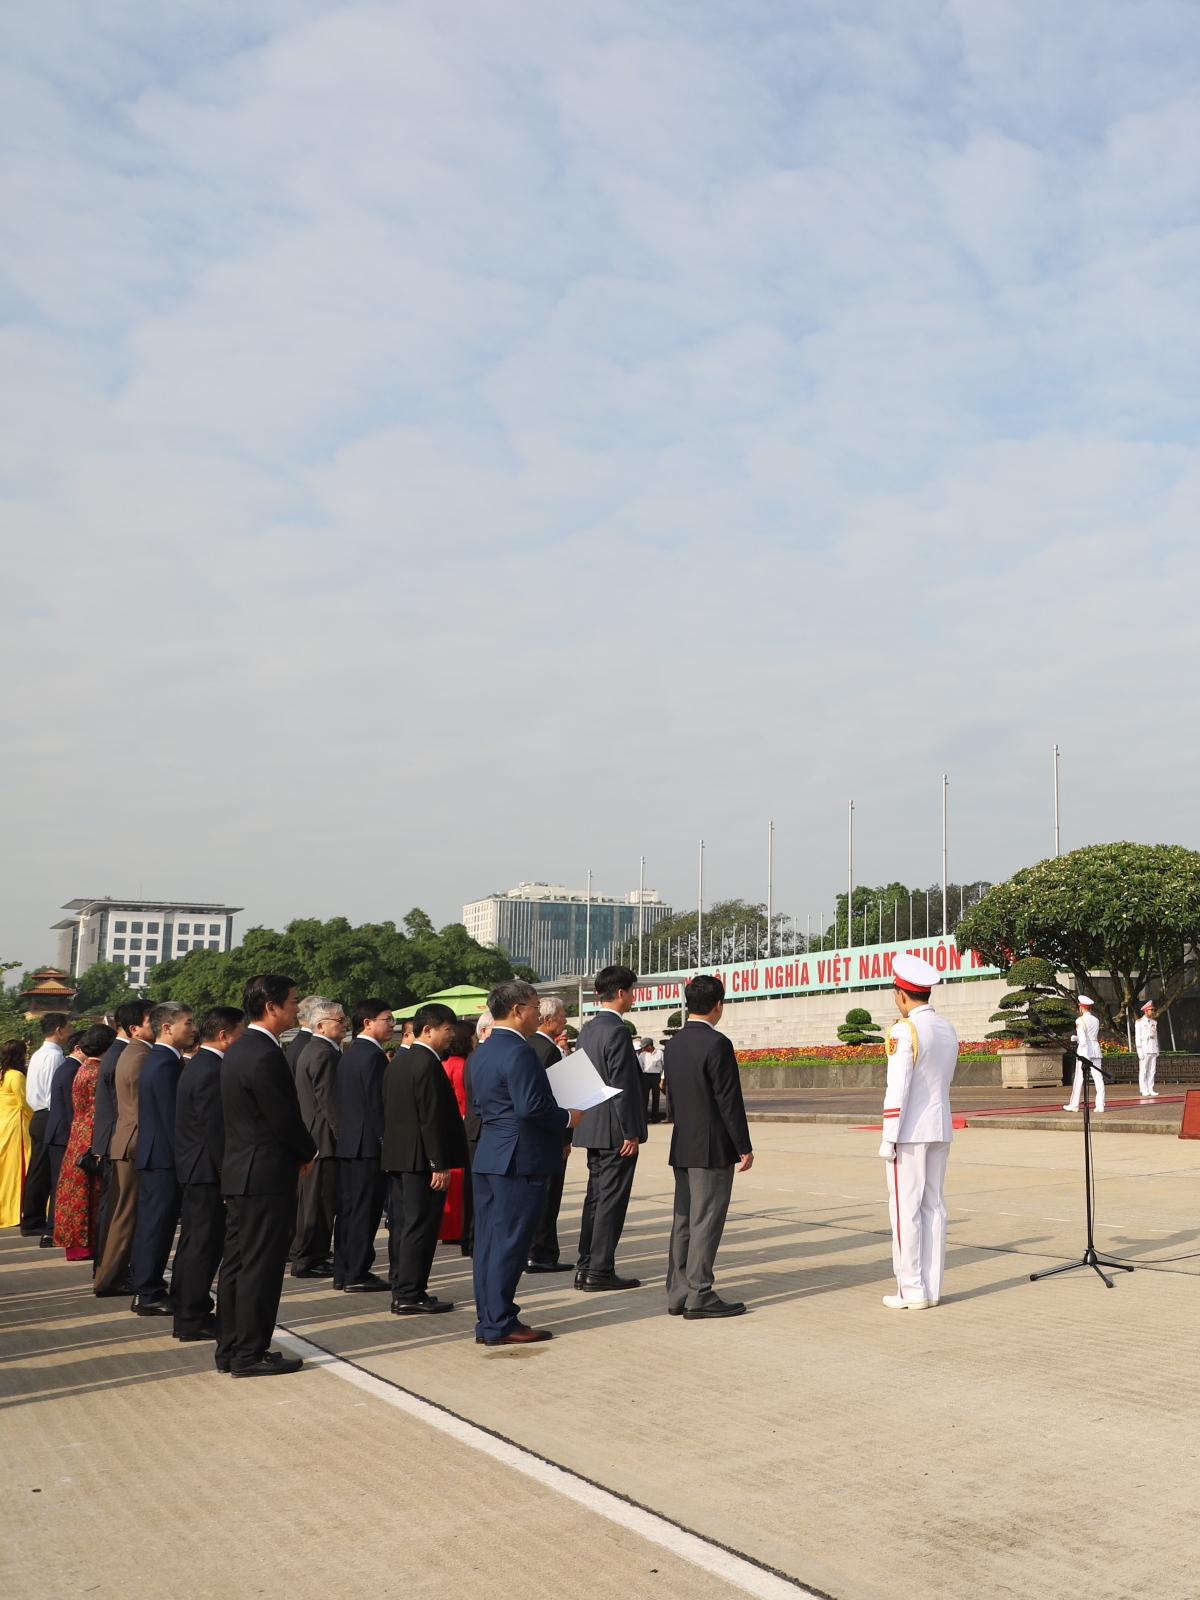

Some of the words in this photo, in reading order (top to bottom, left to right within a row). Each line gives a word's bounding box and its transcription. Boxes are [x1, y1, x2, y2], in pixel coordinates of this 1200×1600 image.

[732, 962, 759, 992] CHỦ
[764, 959, 810, 989] NGHĨA
[817, 953, 852, 987] VIỆT
[859, 951, 897, 980] NAM
